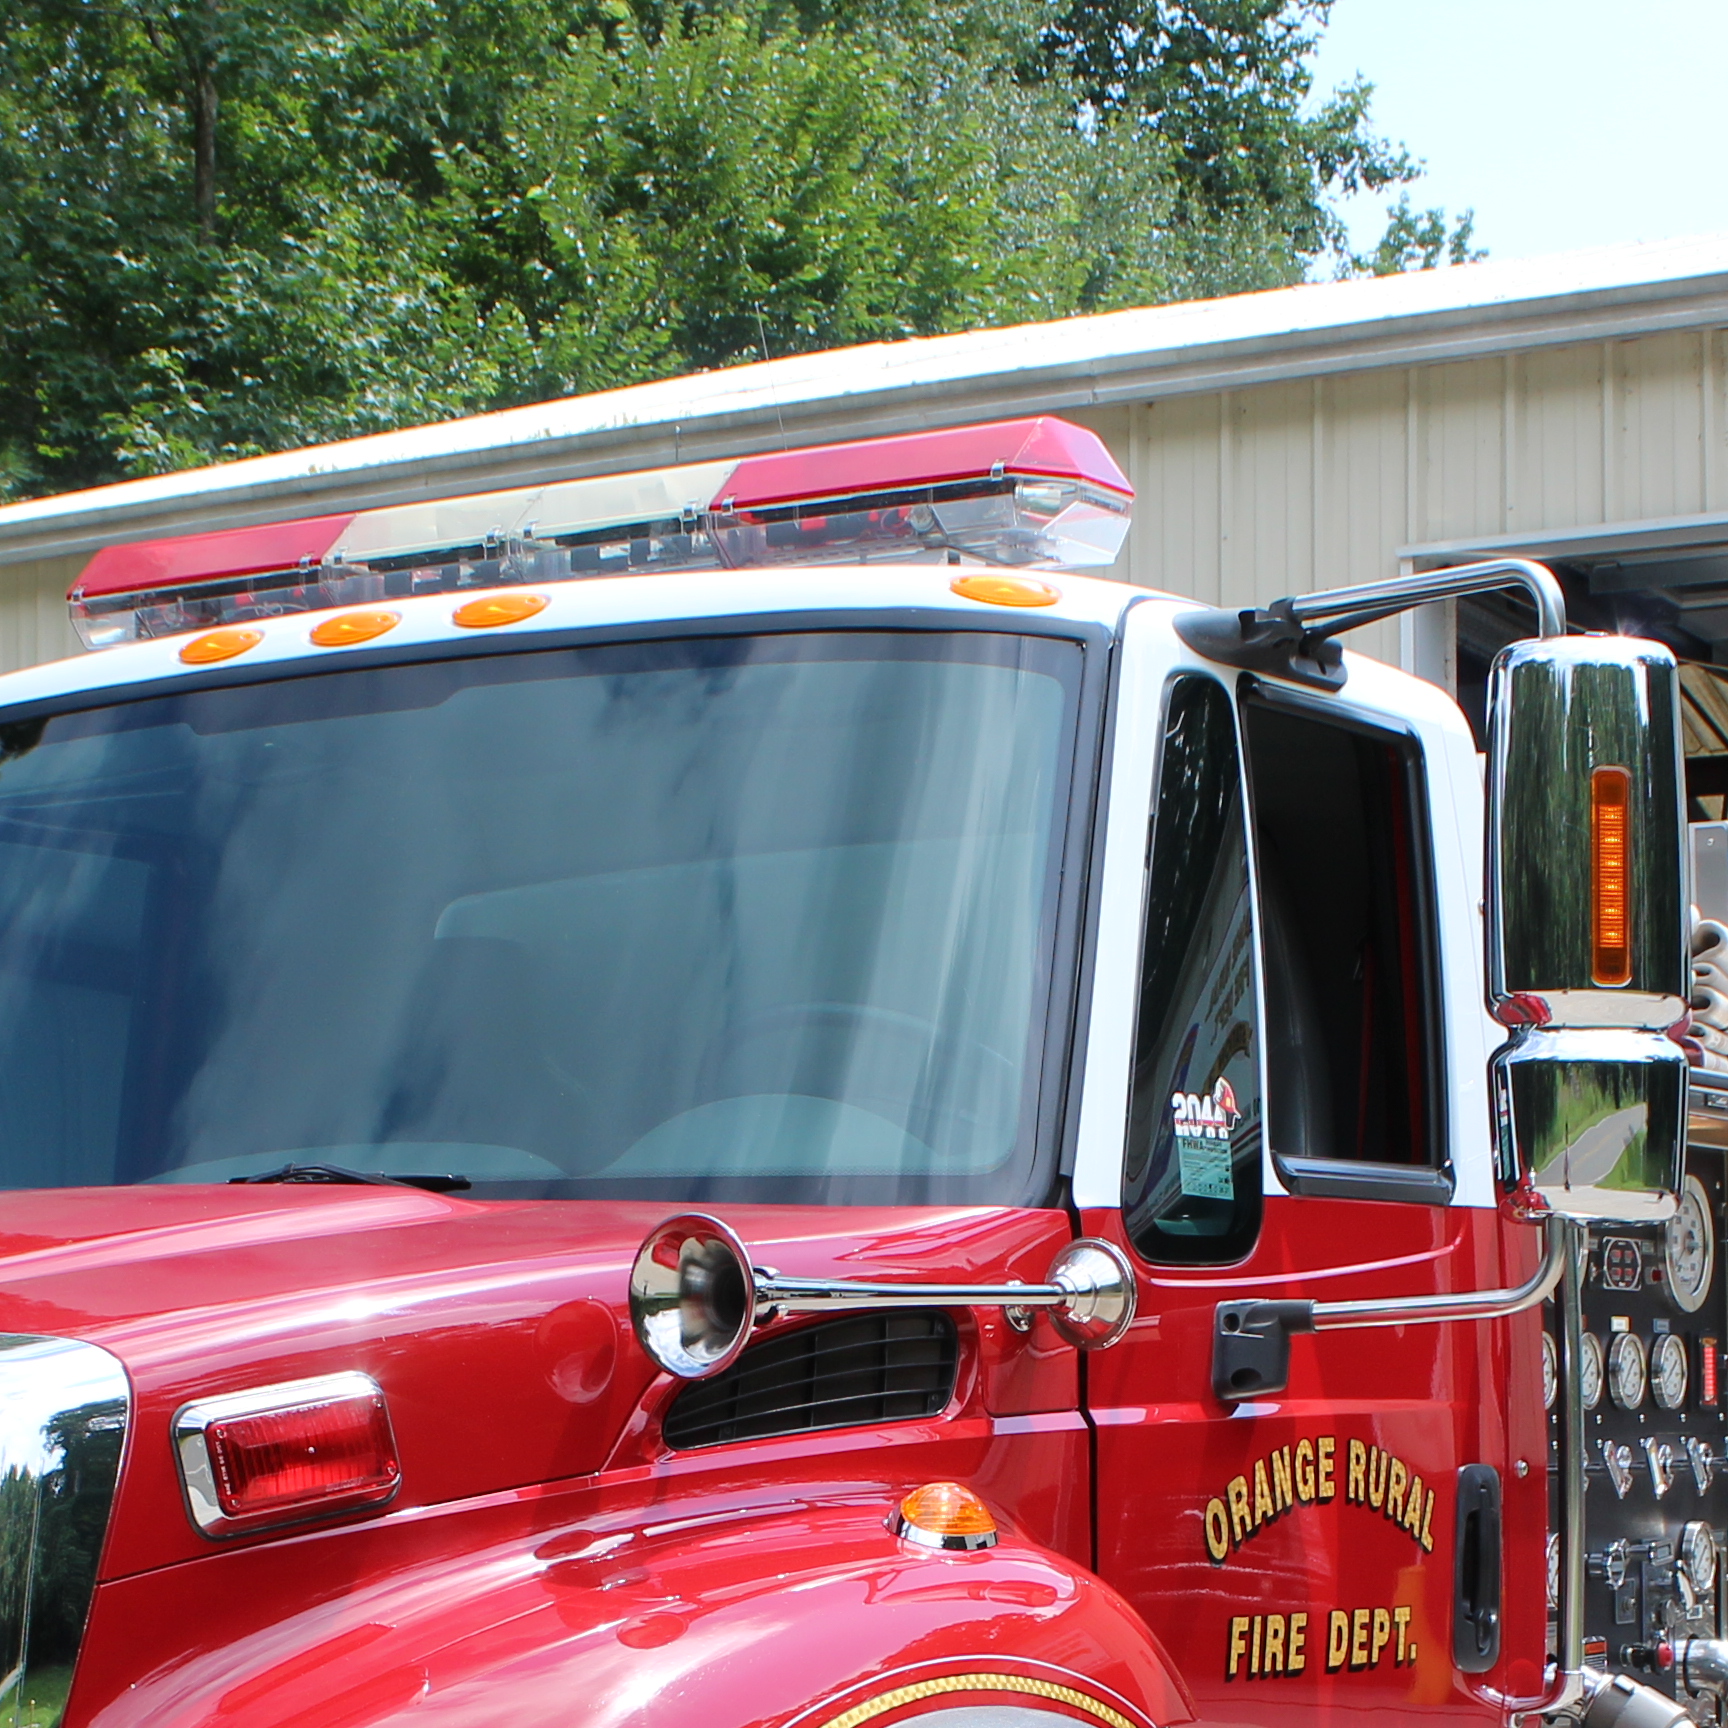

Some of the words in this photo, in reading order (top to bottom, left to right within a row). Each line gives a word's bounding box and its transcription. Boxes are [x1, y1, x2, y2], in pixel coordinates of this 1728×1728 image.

[1205, 1437, 1336, 1564] ORANGE
[1348, 1438, 1435, 1552] RURAL
[1227, 1612, 1308, 1679] FIRE
[1327, 1606, 1418, 1671] DEPT.
